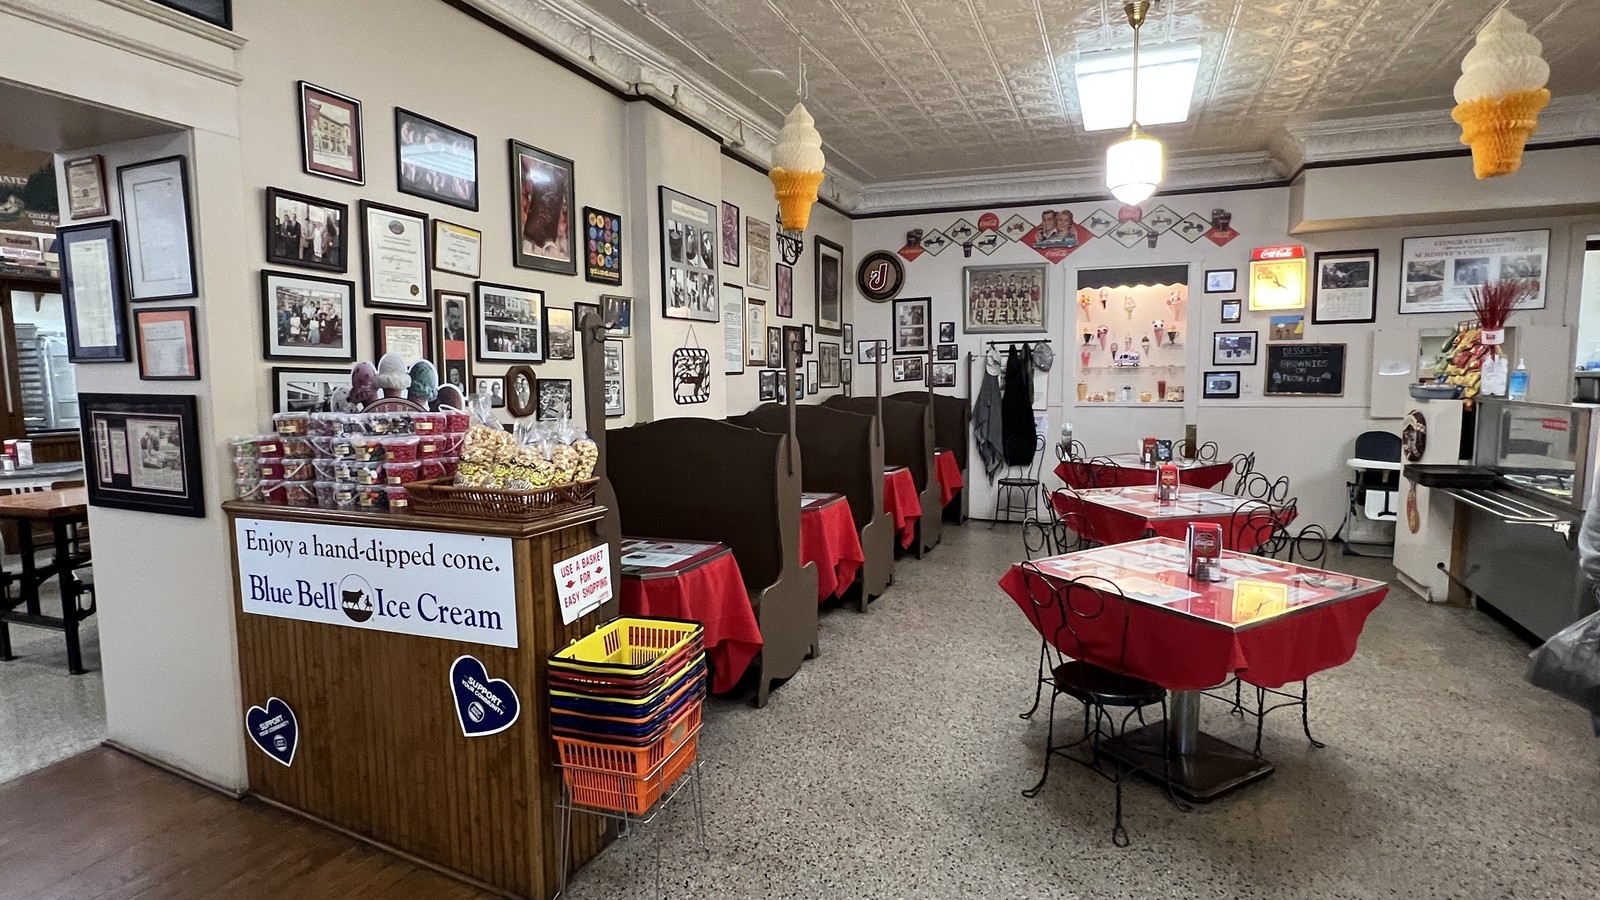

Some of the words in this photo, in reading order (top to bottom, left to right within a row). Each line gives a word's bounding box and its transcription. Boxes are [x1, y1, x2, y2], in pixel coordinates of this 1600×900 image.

[1260, 247, 1293, 259] Coca-Cola
[1280, 359, 1328, 368] BROWNIES
[245, 529, 294, 557] Enjoy
[298, 541, 309, 555] a
[313, 534, 435, 569] hand-dipped
[442, 552, 501, 572] cone.
[561, 564, 573, 578] USE
[576, 561, 580, 571] A
[581, 550, 603, 568] BASKET
[579, 571, 591, 584] FOR
[248, 574, 293, 604] Blue
[295, 579, 338, 610] Bell
[375, 588, 411, 619] Ice
[417, 592, 503, 630] Cream
[564, 591, 580, 608] EASY
[582, 577, 608, 598] SHOPPING
[461, 679, 475, 693] YOUR
[474, 690, 504, 716] COMMUNITY
[467, 676, 503, 706] SUPPORT
[259, 714, 283, 730] SUPPORT
